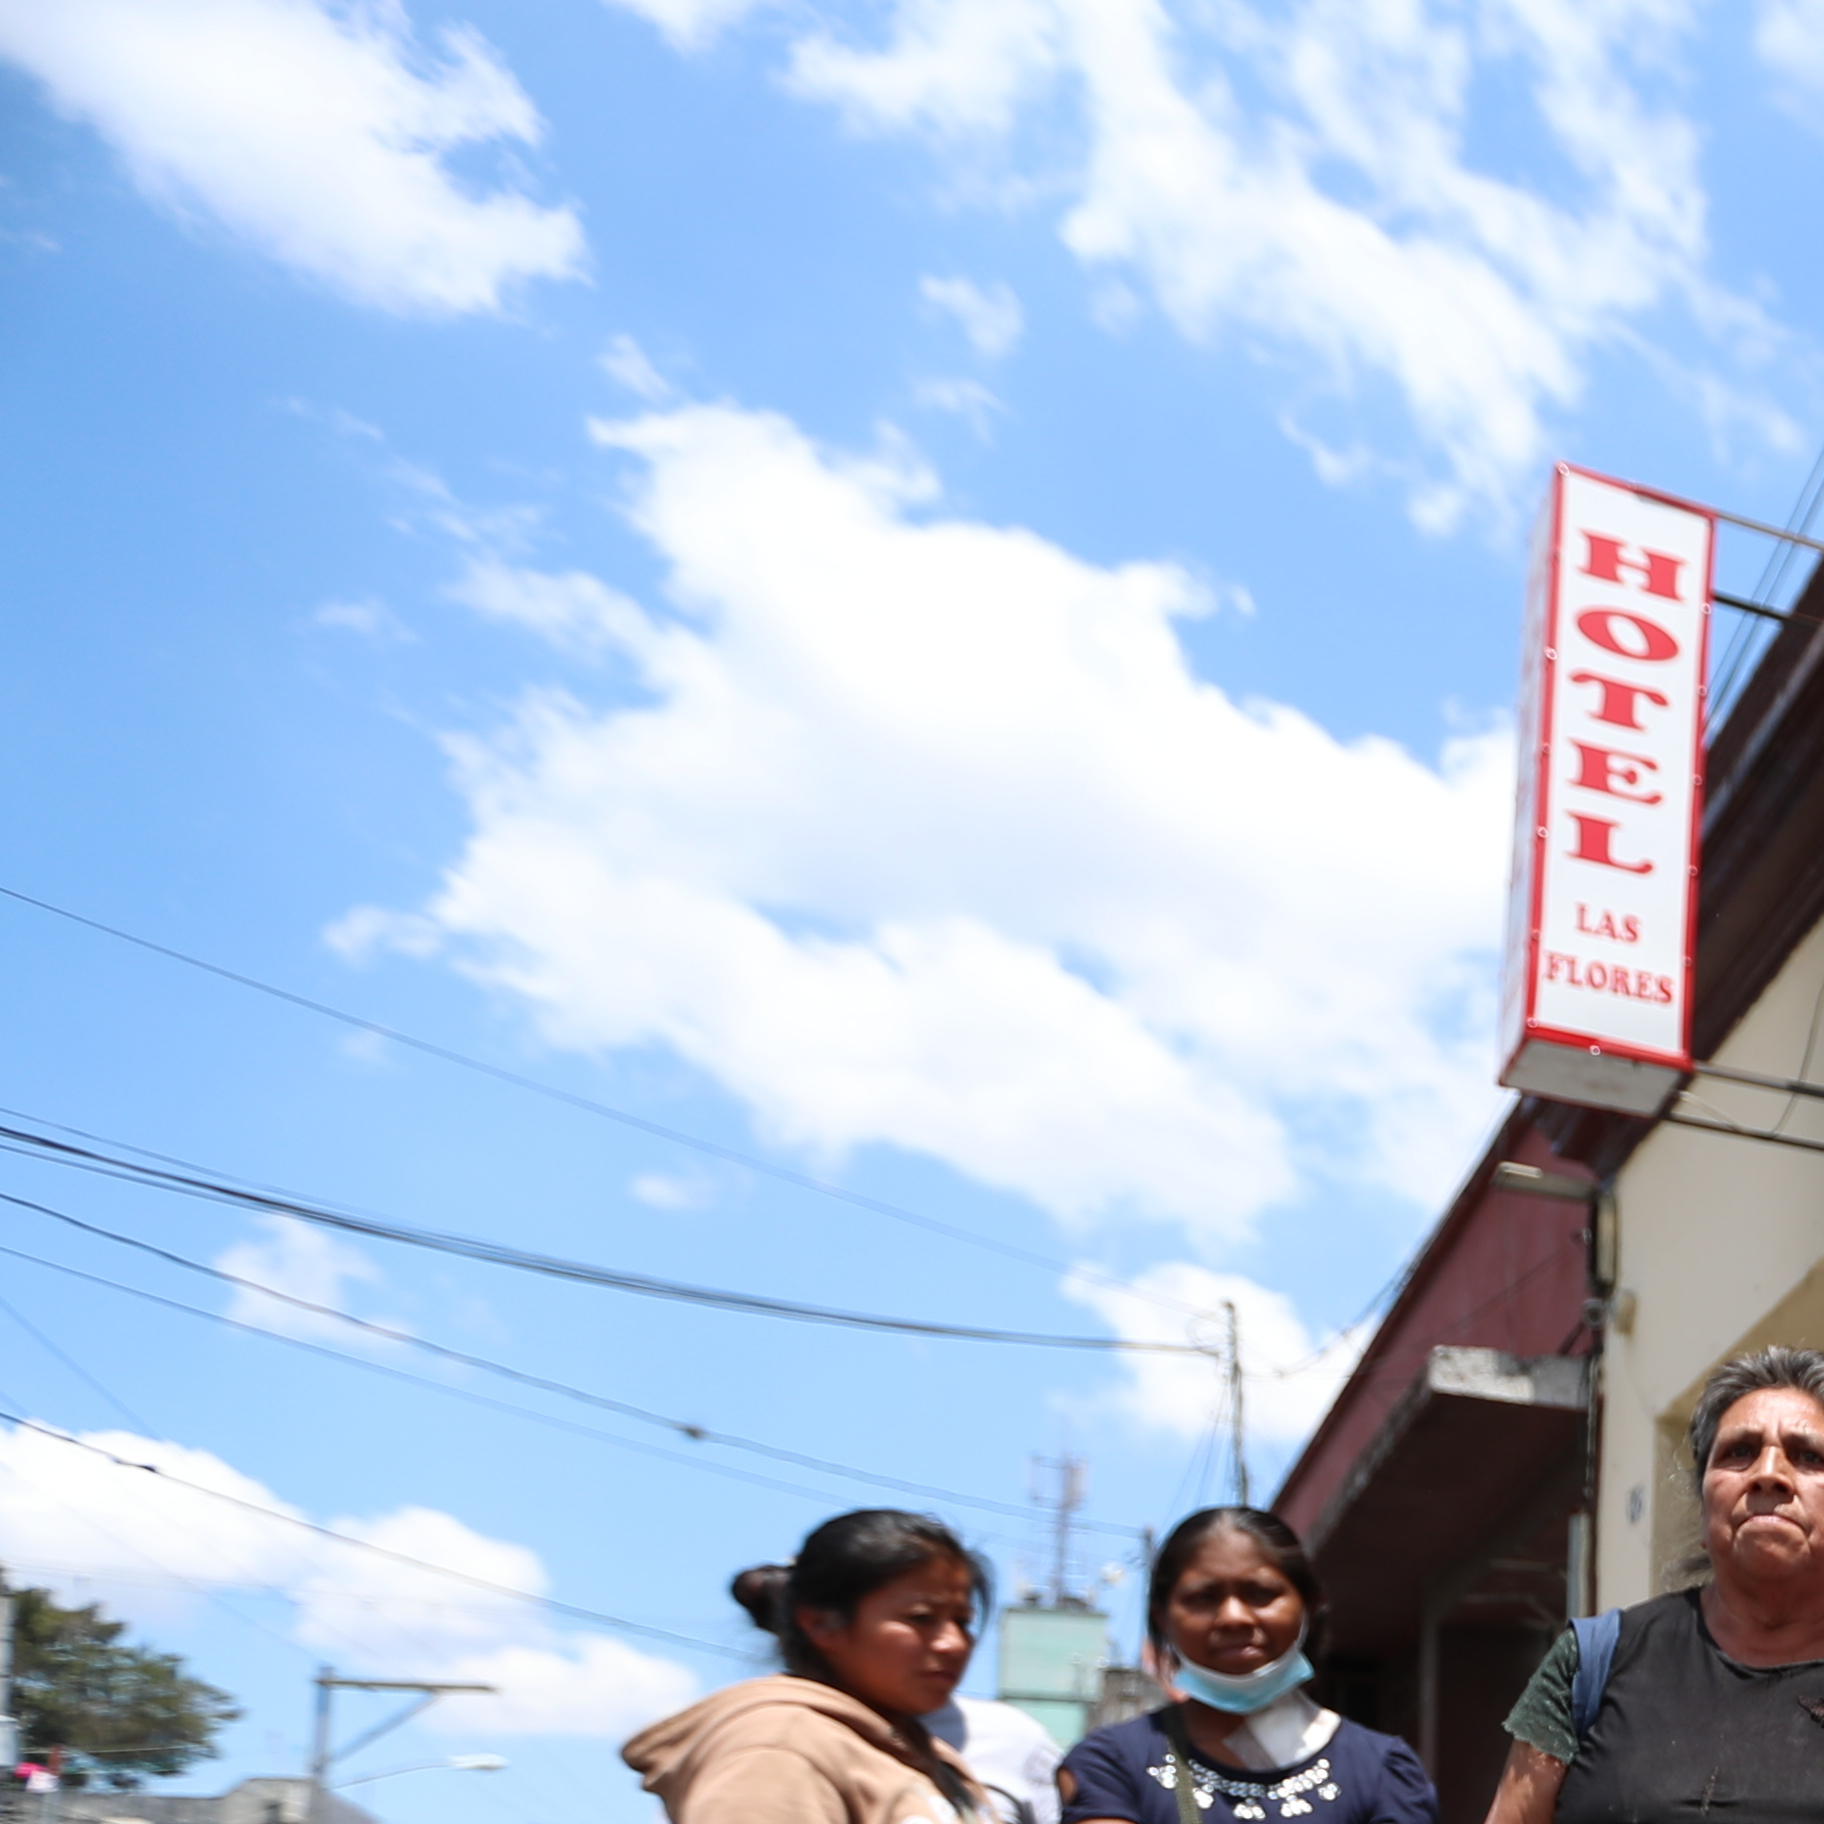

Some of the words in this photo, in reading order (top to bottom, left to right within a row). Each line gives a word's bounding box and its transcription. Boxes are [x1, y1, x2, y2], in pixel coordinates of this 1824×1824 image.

[1565, 529, 1688, 874] HOTEL
[1576, 903, 1641, 943] LAS
[1546, 952, 1673, 1004] FLORES
